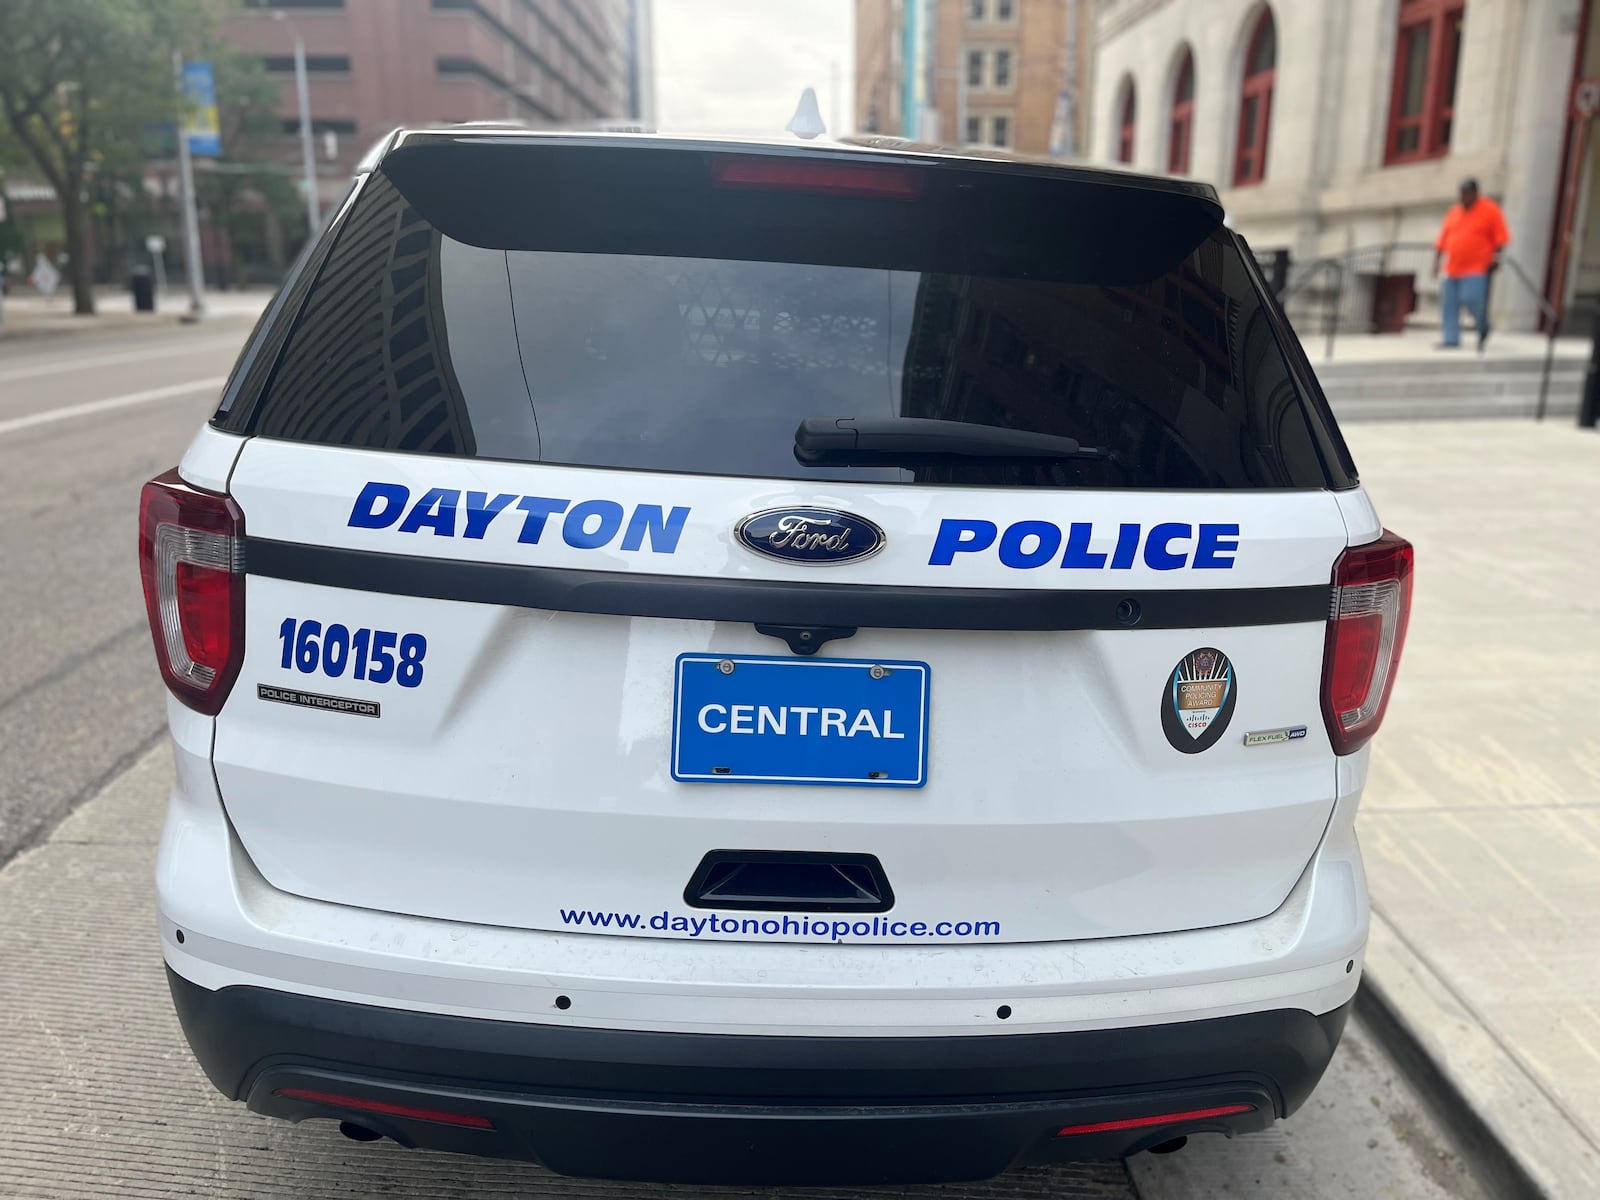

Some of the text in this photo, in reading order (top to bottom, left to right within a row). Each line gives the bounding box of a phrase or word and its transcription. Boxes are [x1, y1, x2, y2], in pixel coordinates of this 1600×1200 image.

[348, 482, 1240, 570] DAYTON POLICE
[769, 516, 850, 551] Ford
[279, 617, 427, 688] 160158
[261, 688, 375, 713] POLICE INTERCEPTOR
[1181, 684, 1223, 693] COMMUNITY
[1185, 692, 1217, 700] POLICING
[1187, 699, 1213, 707] AWARD
[697, 704, 904, 739] CENTRAL
[560, 908, 1001, 940] www.daytonohiopolice.com
